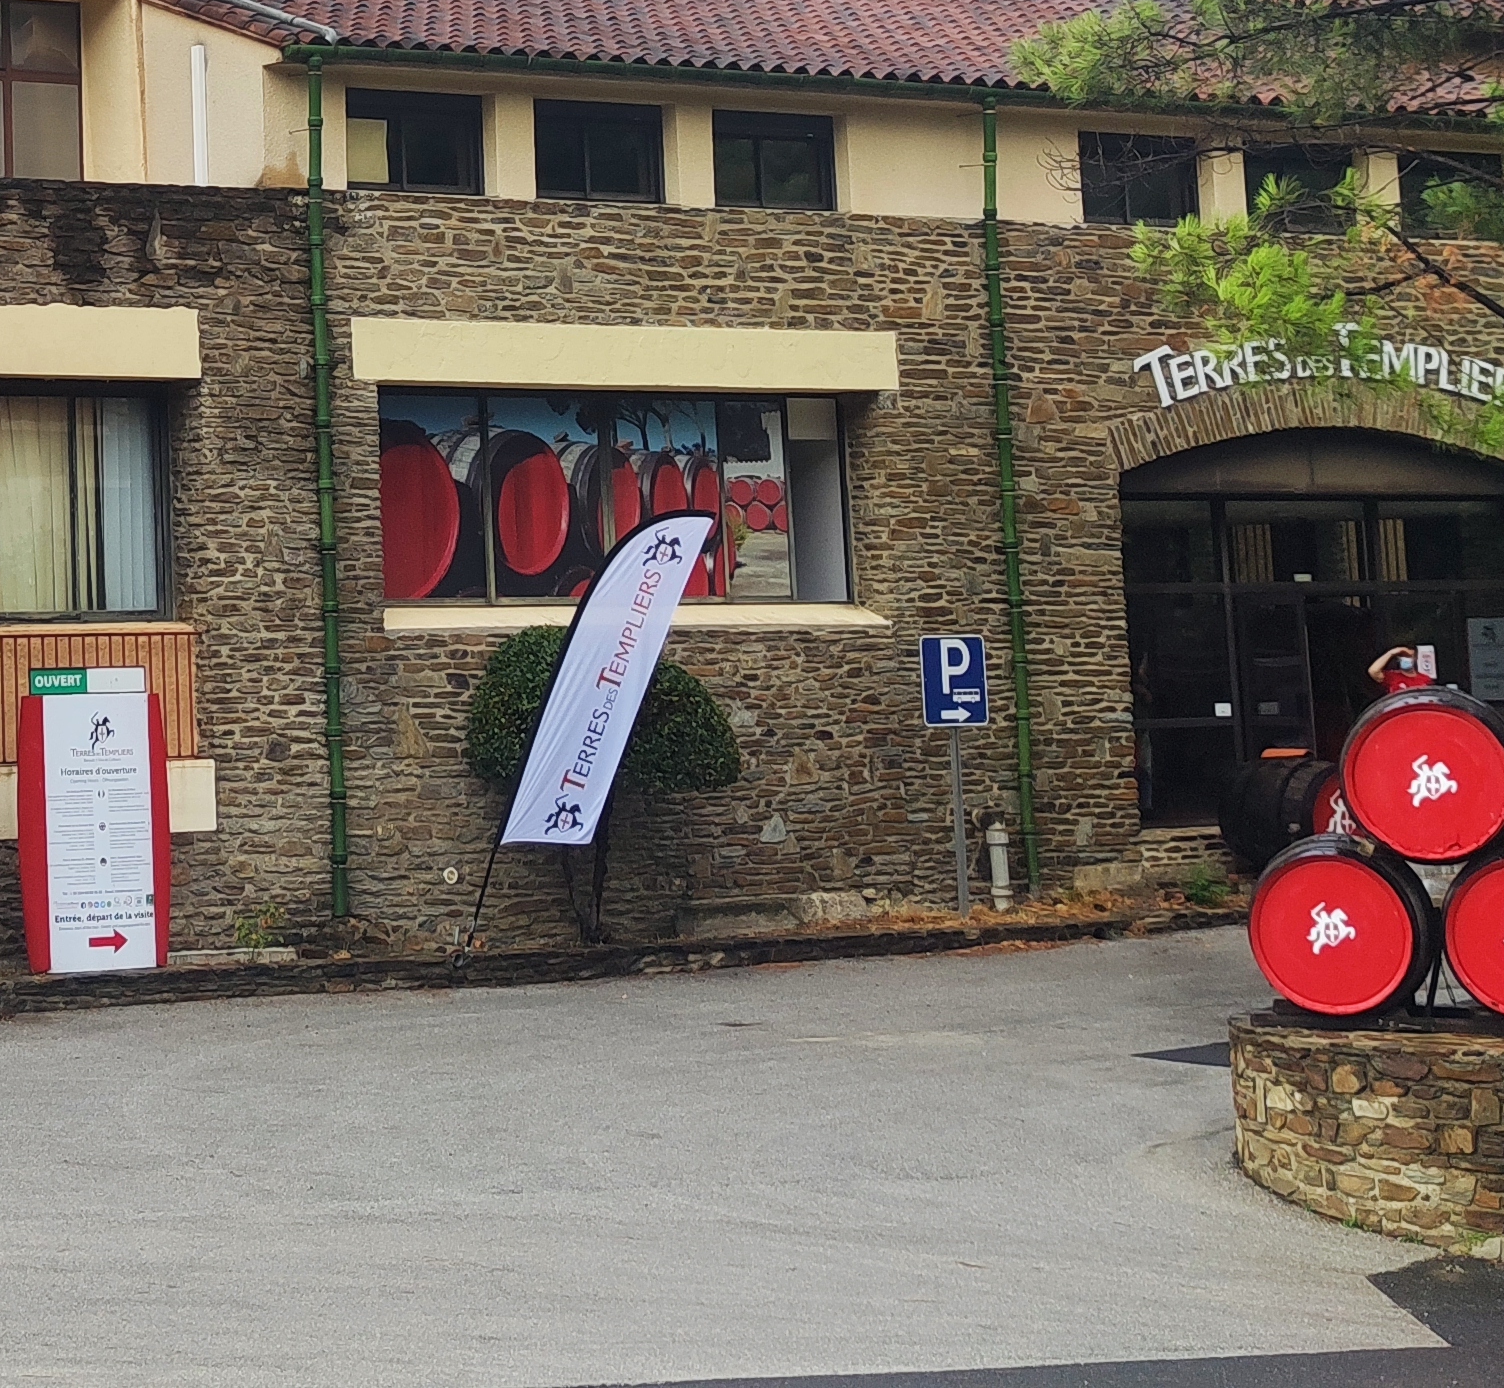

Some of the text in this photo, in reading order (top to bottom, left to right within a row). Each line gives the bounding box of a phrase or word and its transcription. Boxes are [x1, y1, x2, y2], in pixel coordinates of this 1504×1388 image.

[1133, 337, 1291, 408] TERRES
[1296, 355, 1334, 378] DES
[940, 638, 971, 695] P
[34, 674, 82, 688] OUVERT
[559, 568, 662, 792] TERRES DES TEMPLIERS
[70, 748, 96, 757] TERRES
[60, 766, 137, 777] Horaires d'ouverture
[55, 910, 154, 923] Entrée, départ de la visite
